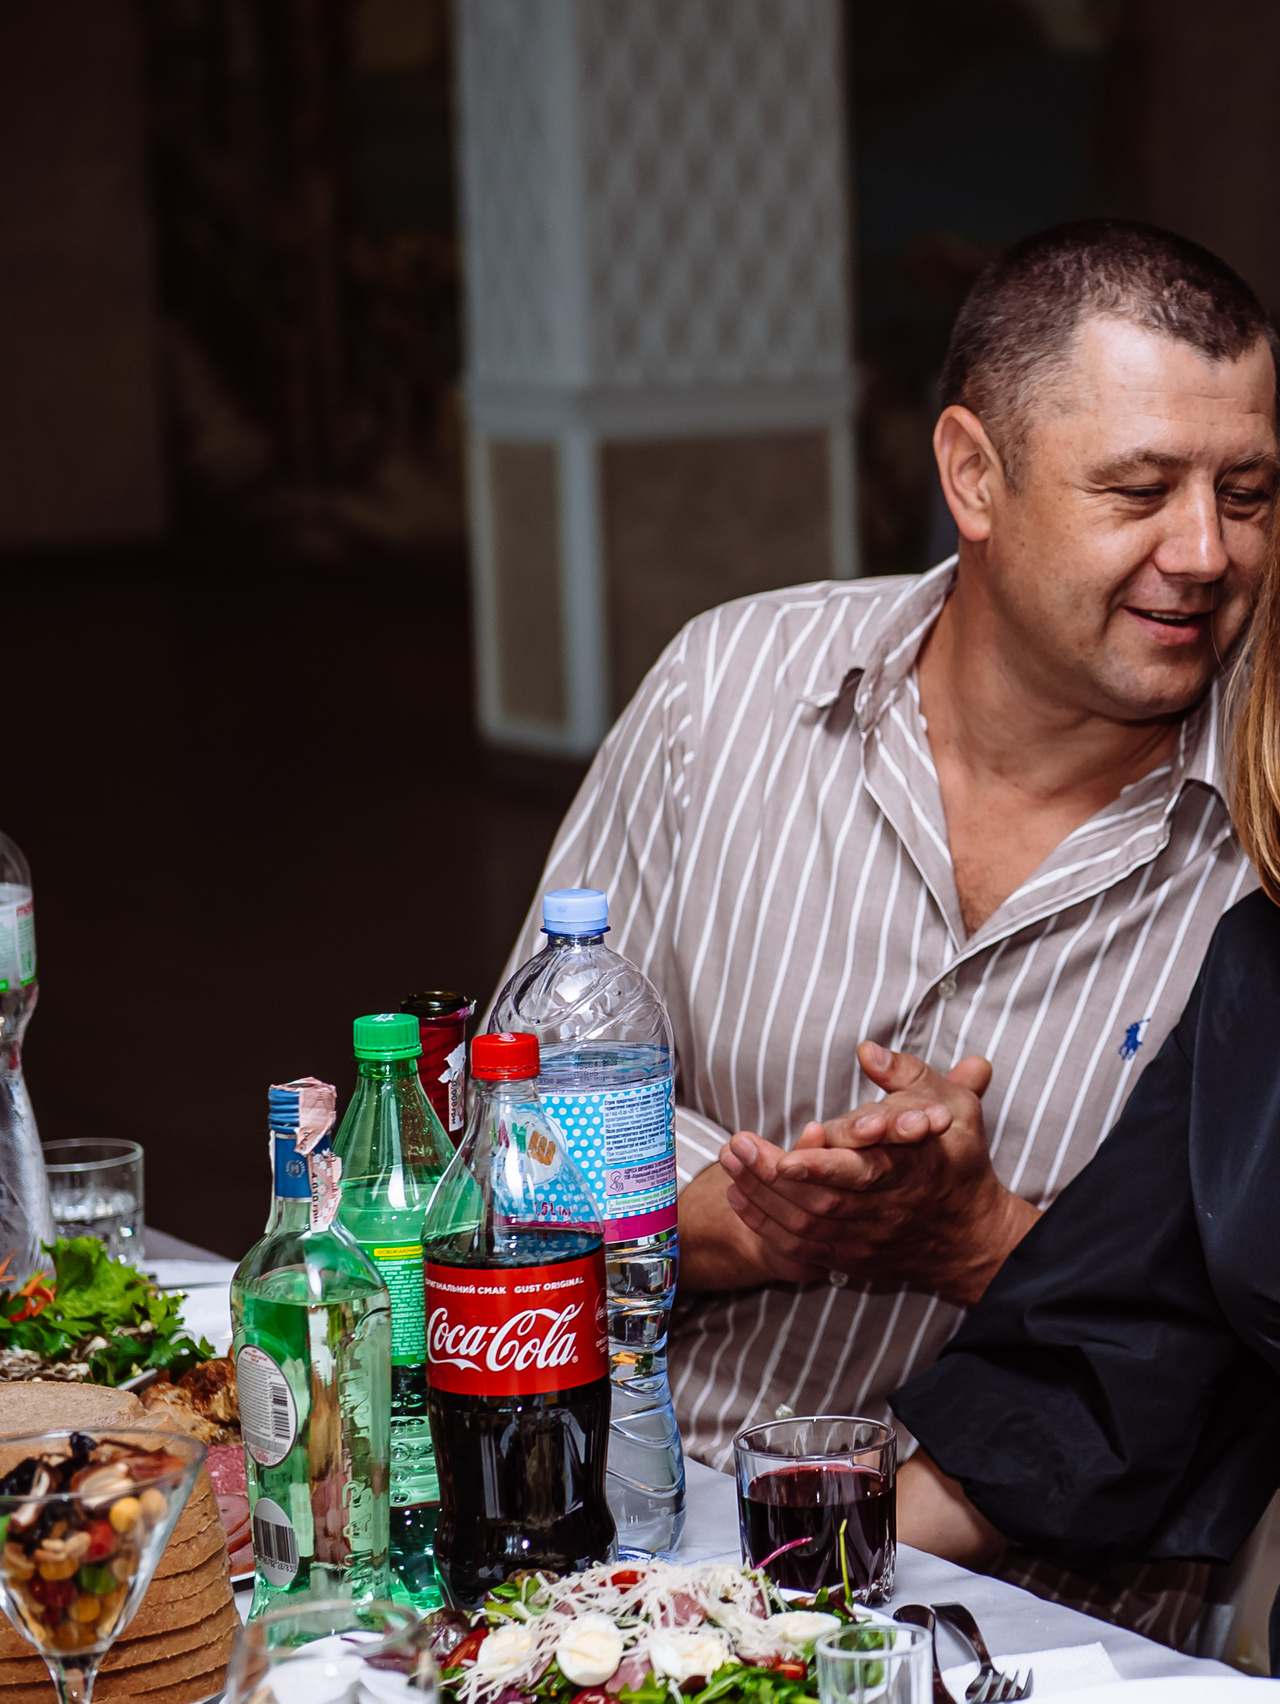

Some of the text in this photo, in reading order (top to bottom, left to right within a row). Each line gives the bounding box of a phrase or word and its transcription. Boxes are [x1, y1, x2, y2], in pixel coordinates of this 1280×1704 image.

[477, 1286, 507, 1295] СМАК
[514, 1276, 585, 1294] GUST ORIGINAL
[426, 1301, 585, 1373] Coca-Cola
